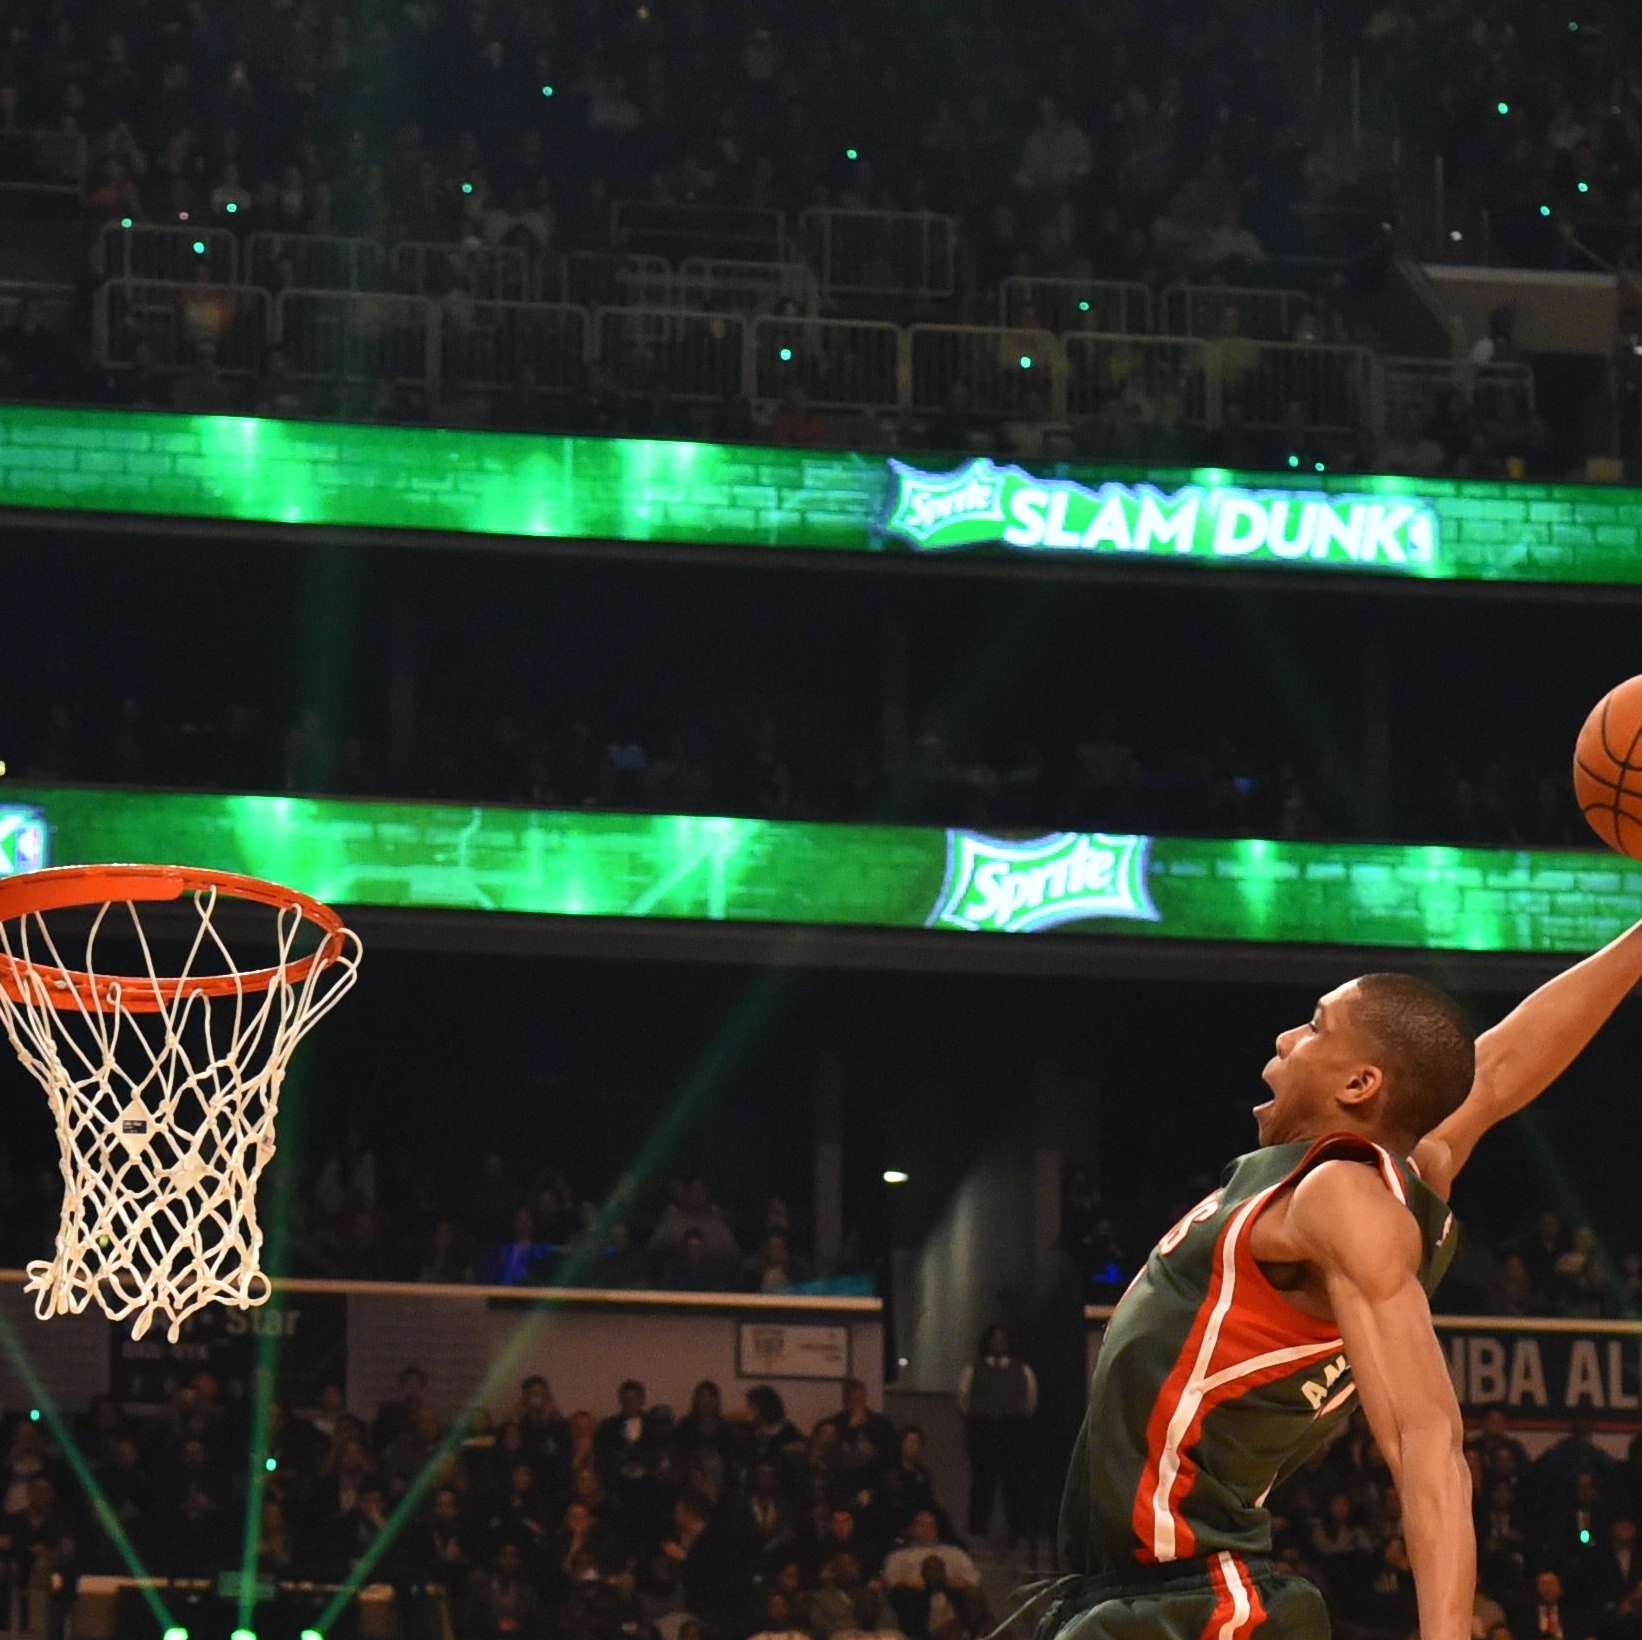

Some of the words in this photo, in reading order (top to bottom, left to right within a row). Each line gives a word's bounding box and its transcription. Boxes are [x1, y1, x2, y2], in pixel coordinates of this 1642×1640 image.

[1002, 491, 1198, 552] SLAM
[1213, 499, 1409, 562] DUNK
[965, 836, 1115, 925] Sprite
